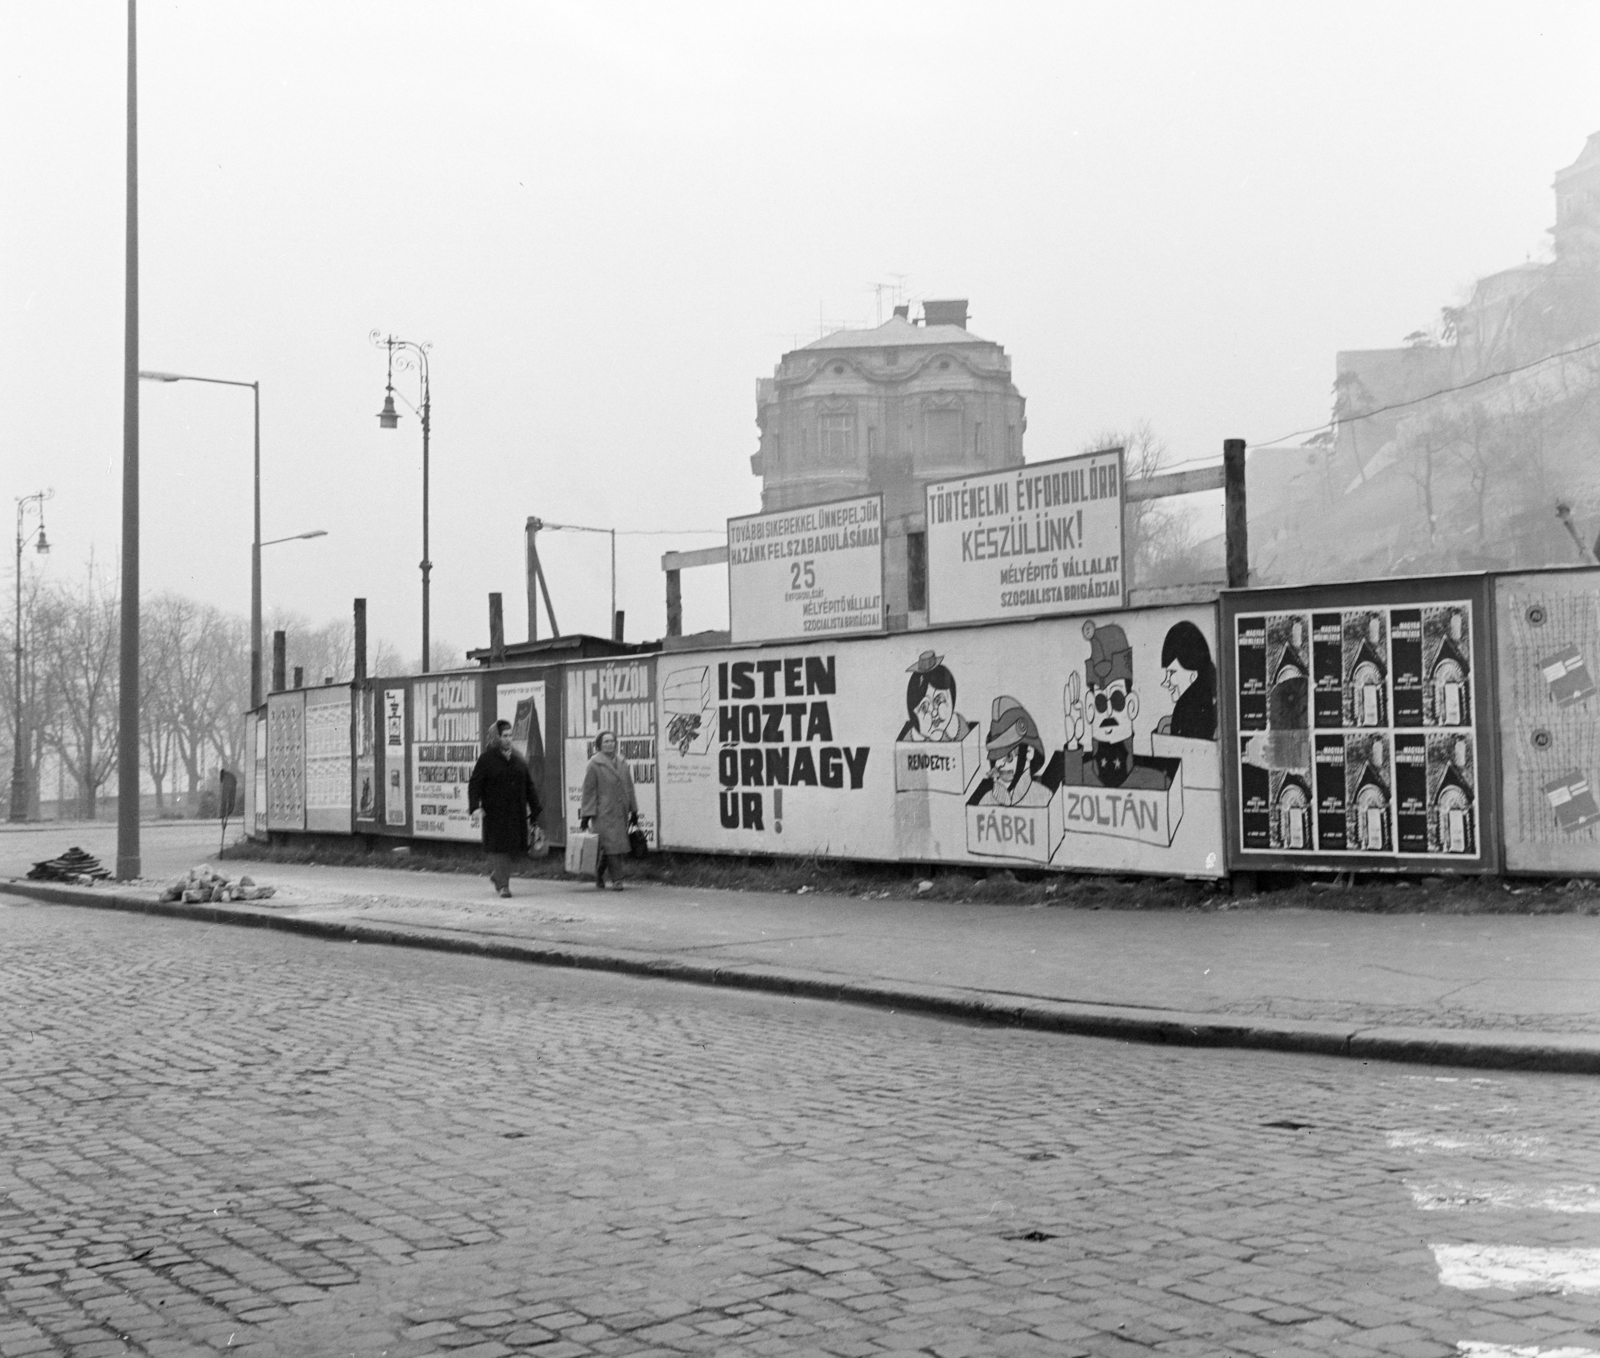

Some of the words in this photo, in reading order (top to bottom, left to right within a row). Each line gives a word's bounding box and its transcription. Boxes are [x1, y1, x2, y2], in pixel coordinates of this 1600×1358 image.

[929, 482, 1009, 525] TÖRTÉNELMI
[1016, 459, 1118, 512] ÉVFORDULÓRA
[731, 519, 764, 544] TOVÁBBI
[766, 513, 818, 538] SIKEREKKEL
[731, 542, 767, 566] HAZÁNK
[767, 524, 880, 560] FELSZABADULÁSÁNAK
[962, 509, 1083, 563] KÉSZÜLÜNK!
[790, 559, 816, 591] 25
[1062, 555, 1119, 578] VÁLLALAT
[847, 594, 881, 612] VÁLLALAT
[1001, 586, 1064, 608] SZOCIALISTA
[1064, 578, 1120, 602] BRIGÁDJAI
[803, 616, 845, 632] SZOCIALISTA
[845, 611, 880, 629] BRIGÁDJAI
[718, 655, 836, 701] ISTEN
[413, 682, 438, 742] NE
[438, 676, 476, 710] FŐZZÖN
[567, 669, 599, 738] NE
[599, 661, 648, 701] FŐZZÖN
[600, 701, 656, 736] OTTHON!
[718, 701, 833, 744] HOZTA
[718, 742, 871, 790] ŐRNAGY
[907, 753, 956, 773] RENDEZTE:
[976, 809, 1036, 846] FÁBRI
[1067, 793, 1159, 832] ZOLTÁN
